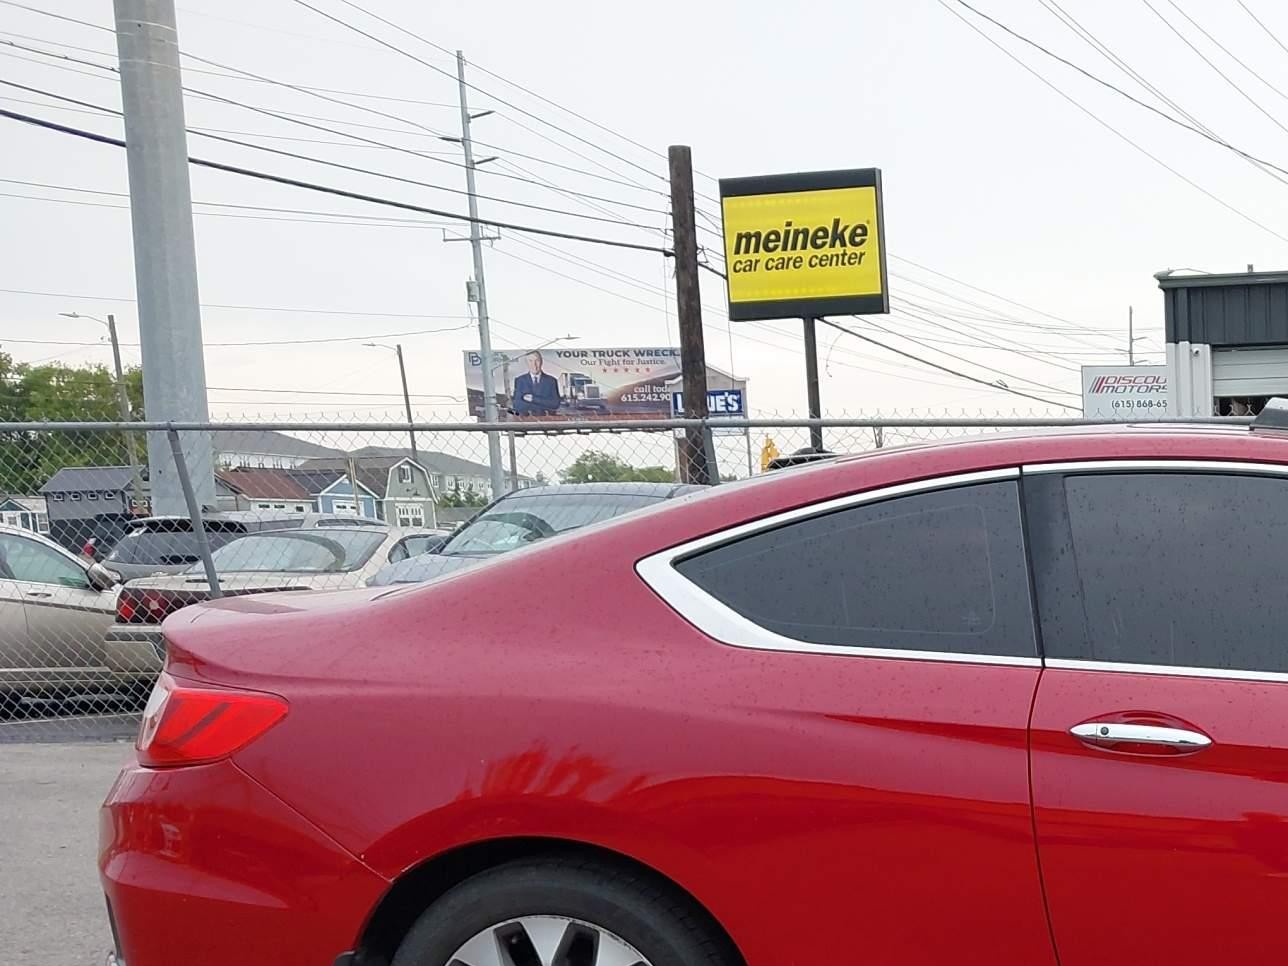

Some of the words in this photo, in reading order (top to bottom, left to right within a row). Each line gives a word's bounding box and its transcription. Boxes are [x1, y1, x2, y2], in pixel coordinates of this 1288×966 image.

[734, 218, 867, 255] meineke
[733, 258, 760, 273] car
[764, 255, 803, 271] care
[808, 249, 866, 269] center
[556, 350, 588, 358] YOUR
[591, 350, 630, 358] TRUCK
[598, 358, 621, 367] Fight
[622, 358, 634, 366] for
[634, 385, 650, 393] call
[1111, 399, 1135, 409] (615)
